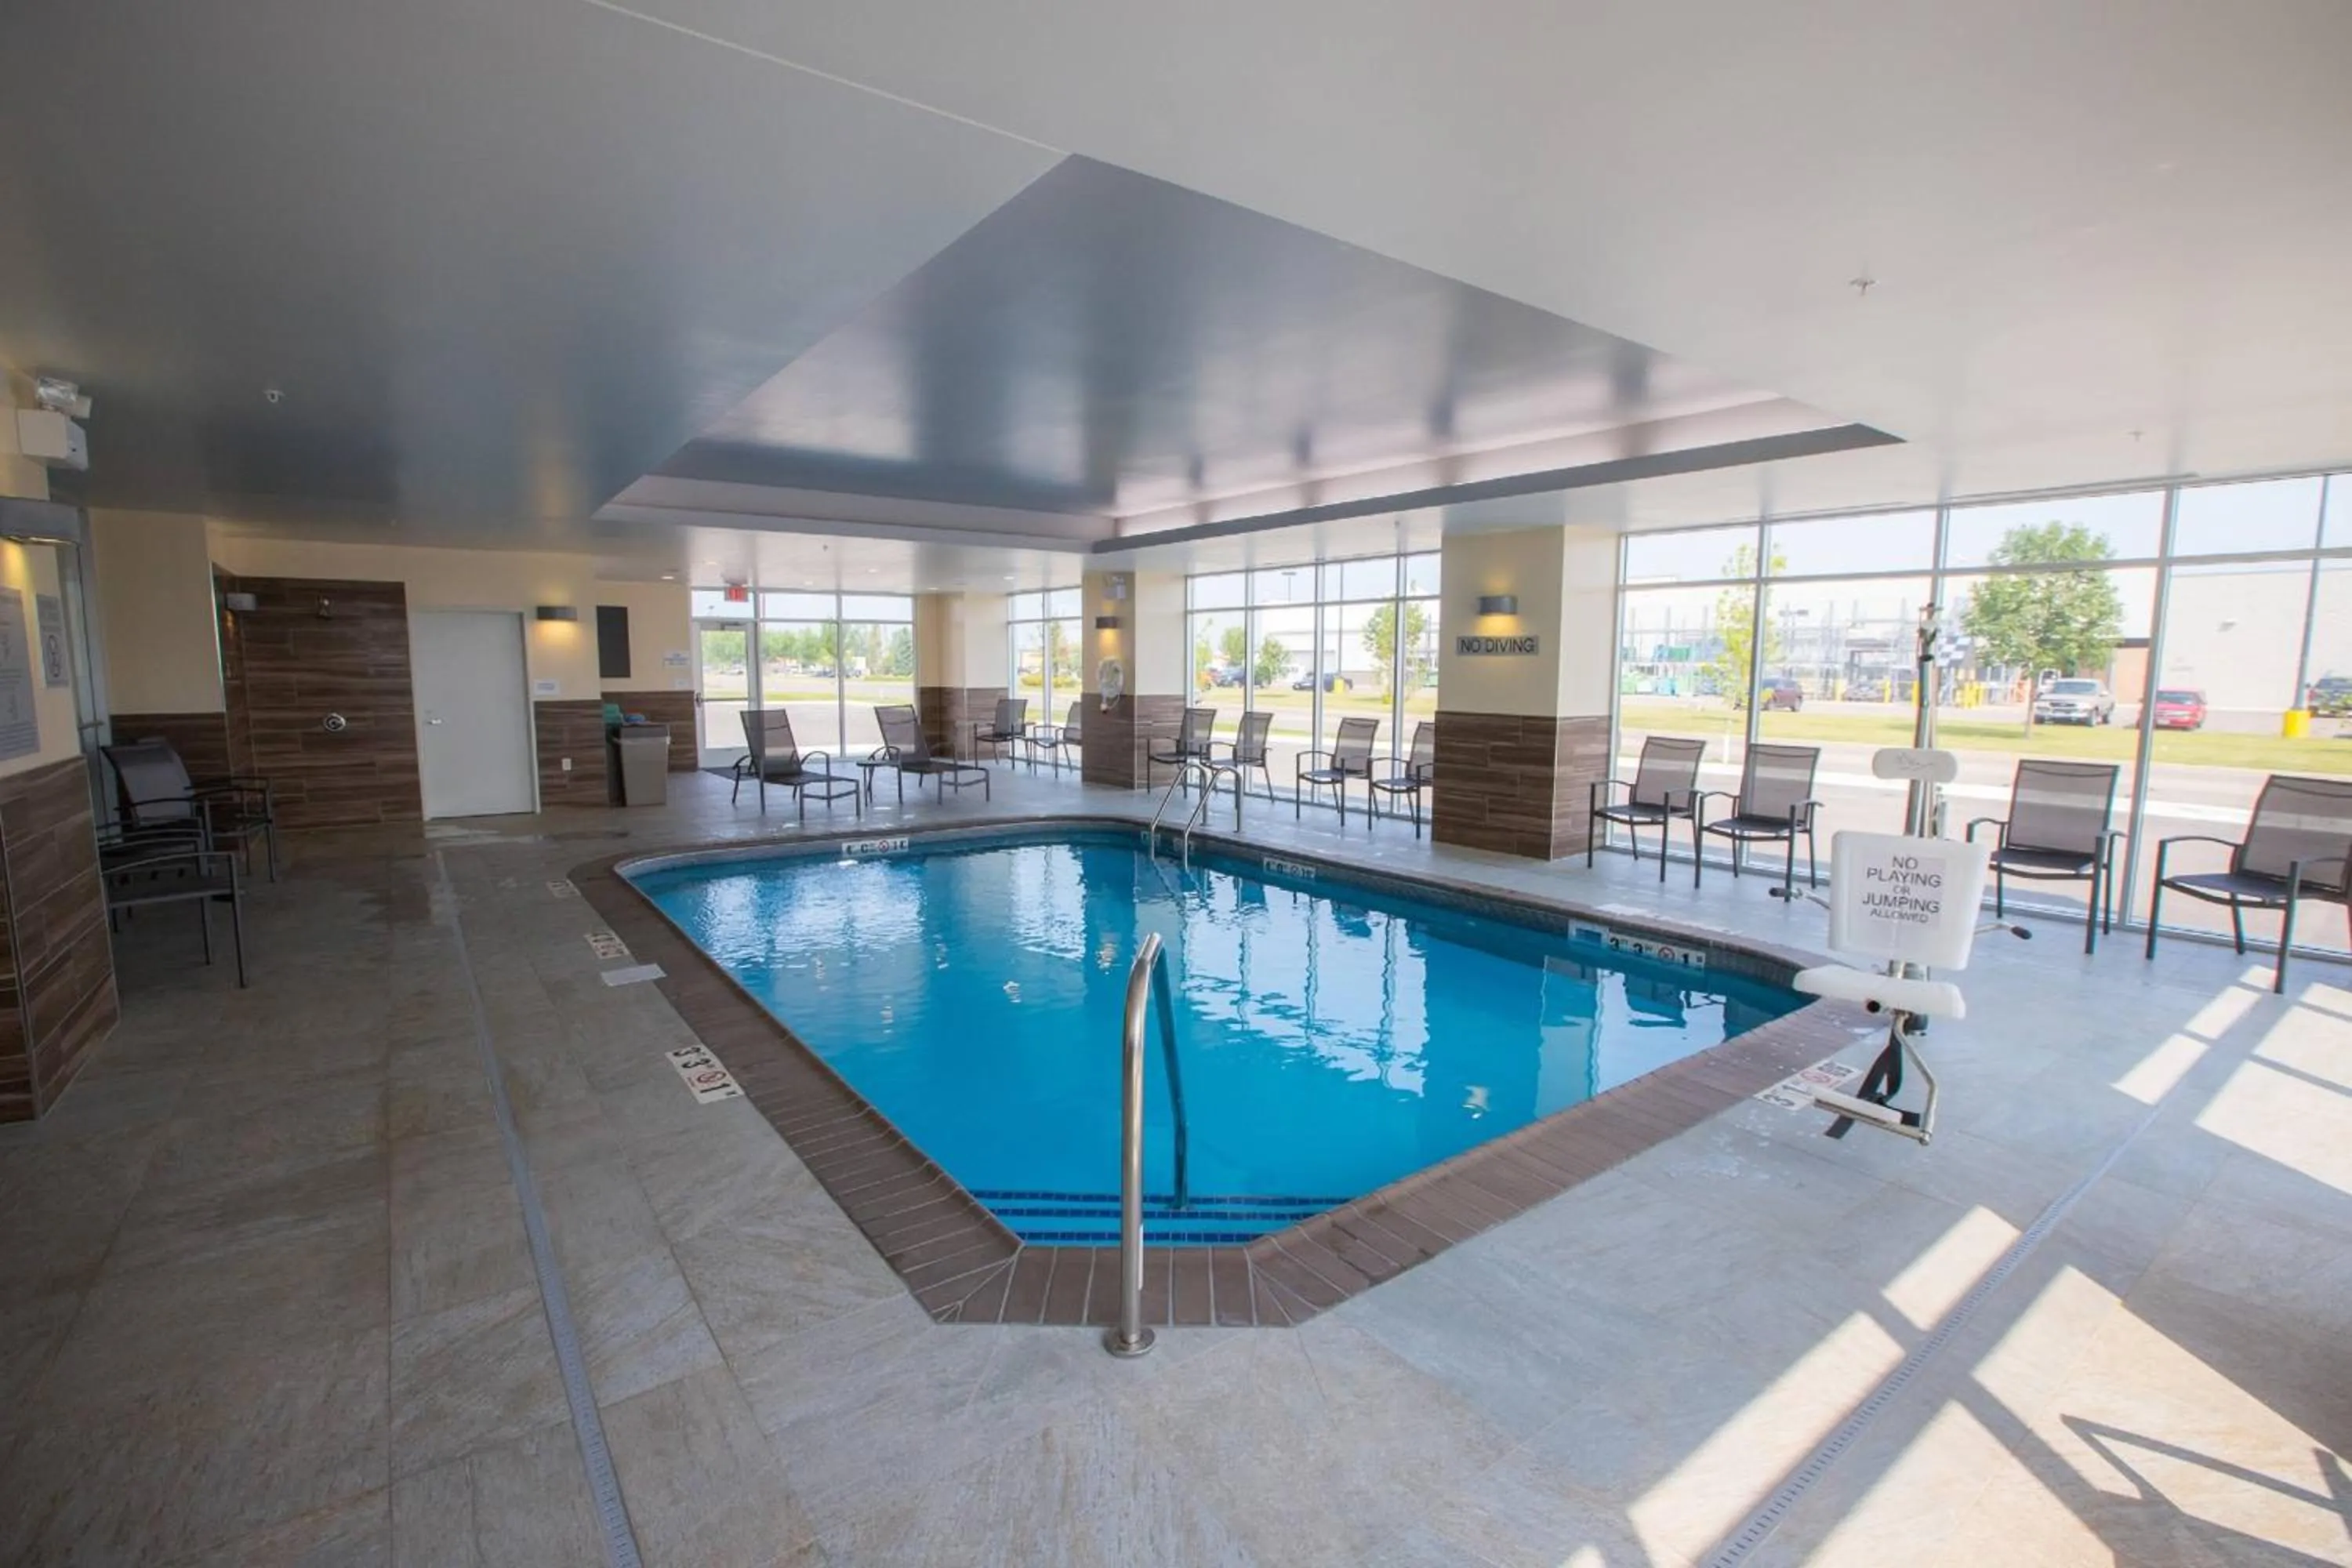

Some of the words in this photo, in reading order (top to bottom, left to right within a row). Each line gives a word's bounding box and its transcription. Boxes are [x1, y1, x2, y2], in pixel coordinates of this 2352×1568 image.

[1460, 638, 1481, 653] NO
[1485, 637, 1535, 653] DIVING
[1891, 855, 1919, 870] NO
[1866, 866, 1942, 888] PLAYING
[1892, 885, 1911, 896] OR
[1862, 892, 1940, 914] JUMPING
[1868, 907, 1929, 924] ALLOWED
